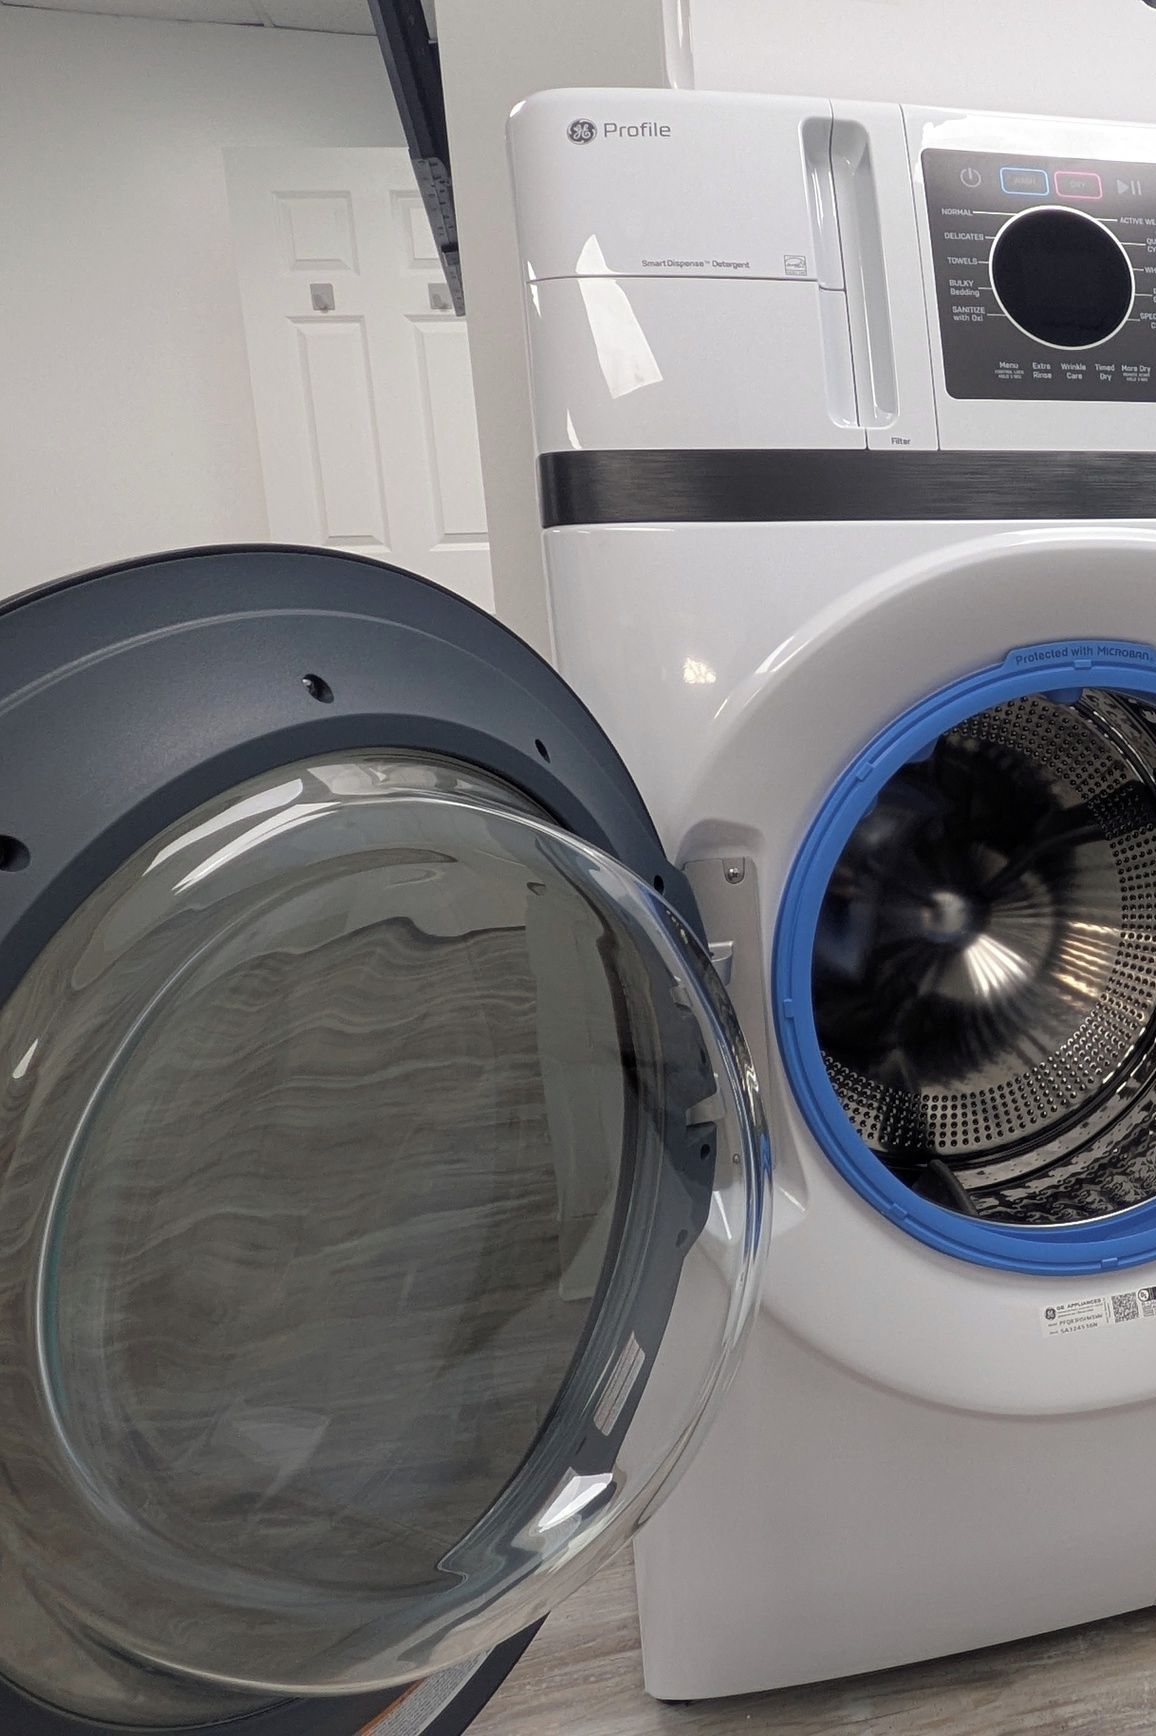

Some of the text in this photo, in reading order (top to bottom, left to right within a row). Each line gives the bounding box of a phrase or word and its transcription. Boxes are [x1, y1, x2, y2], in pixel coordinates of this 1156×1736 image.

[604, 122, 671, 138] Profile
[941, 208, 973, 216] NORMAL
[1120, 217, 1143, 225] ACTIVE
[944, 232, 984, 240] DELICATES
[711, 260, 750, 269] Detergent
[947, 256, 978, 265] TOWELS
[949, 279, 975, 287] BULKY
[950, 288, 980, 297] Bedding
[952, 306, 986, 314] SANITIZE
[999, 361, 1019, 369] Menu
[1032, 362, 1051, 370] Extra
[1061, 363, 1086, 371] Wrinkle
[1095, 363, 1115, 371] Timed
[1121, 364, 1151, 376] More Dry
[1033, 371, 1052, 379] Rinse
[1066, 372, 1083, 380] Care
[1100, 373, 1112, 381] Dry
[891, 437, 911, 445] Filter
[1016, 648, 1068, 665] Protected
[1071, 646, 1093, 656] with
